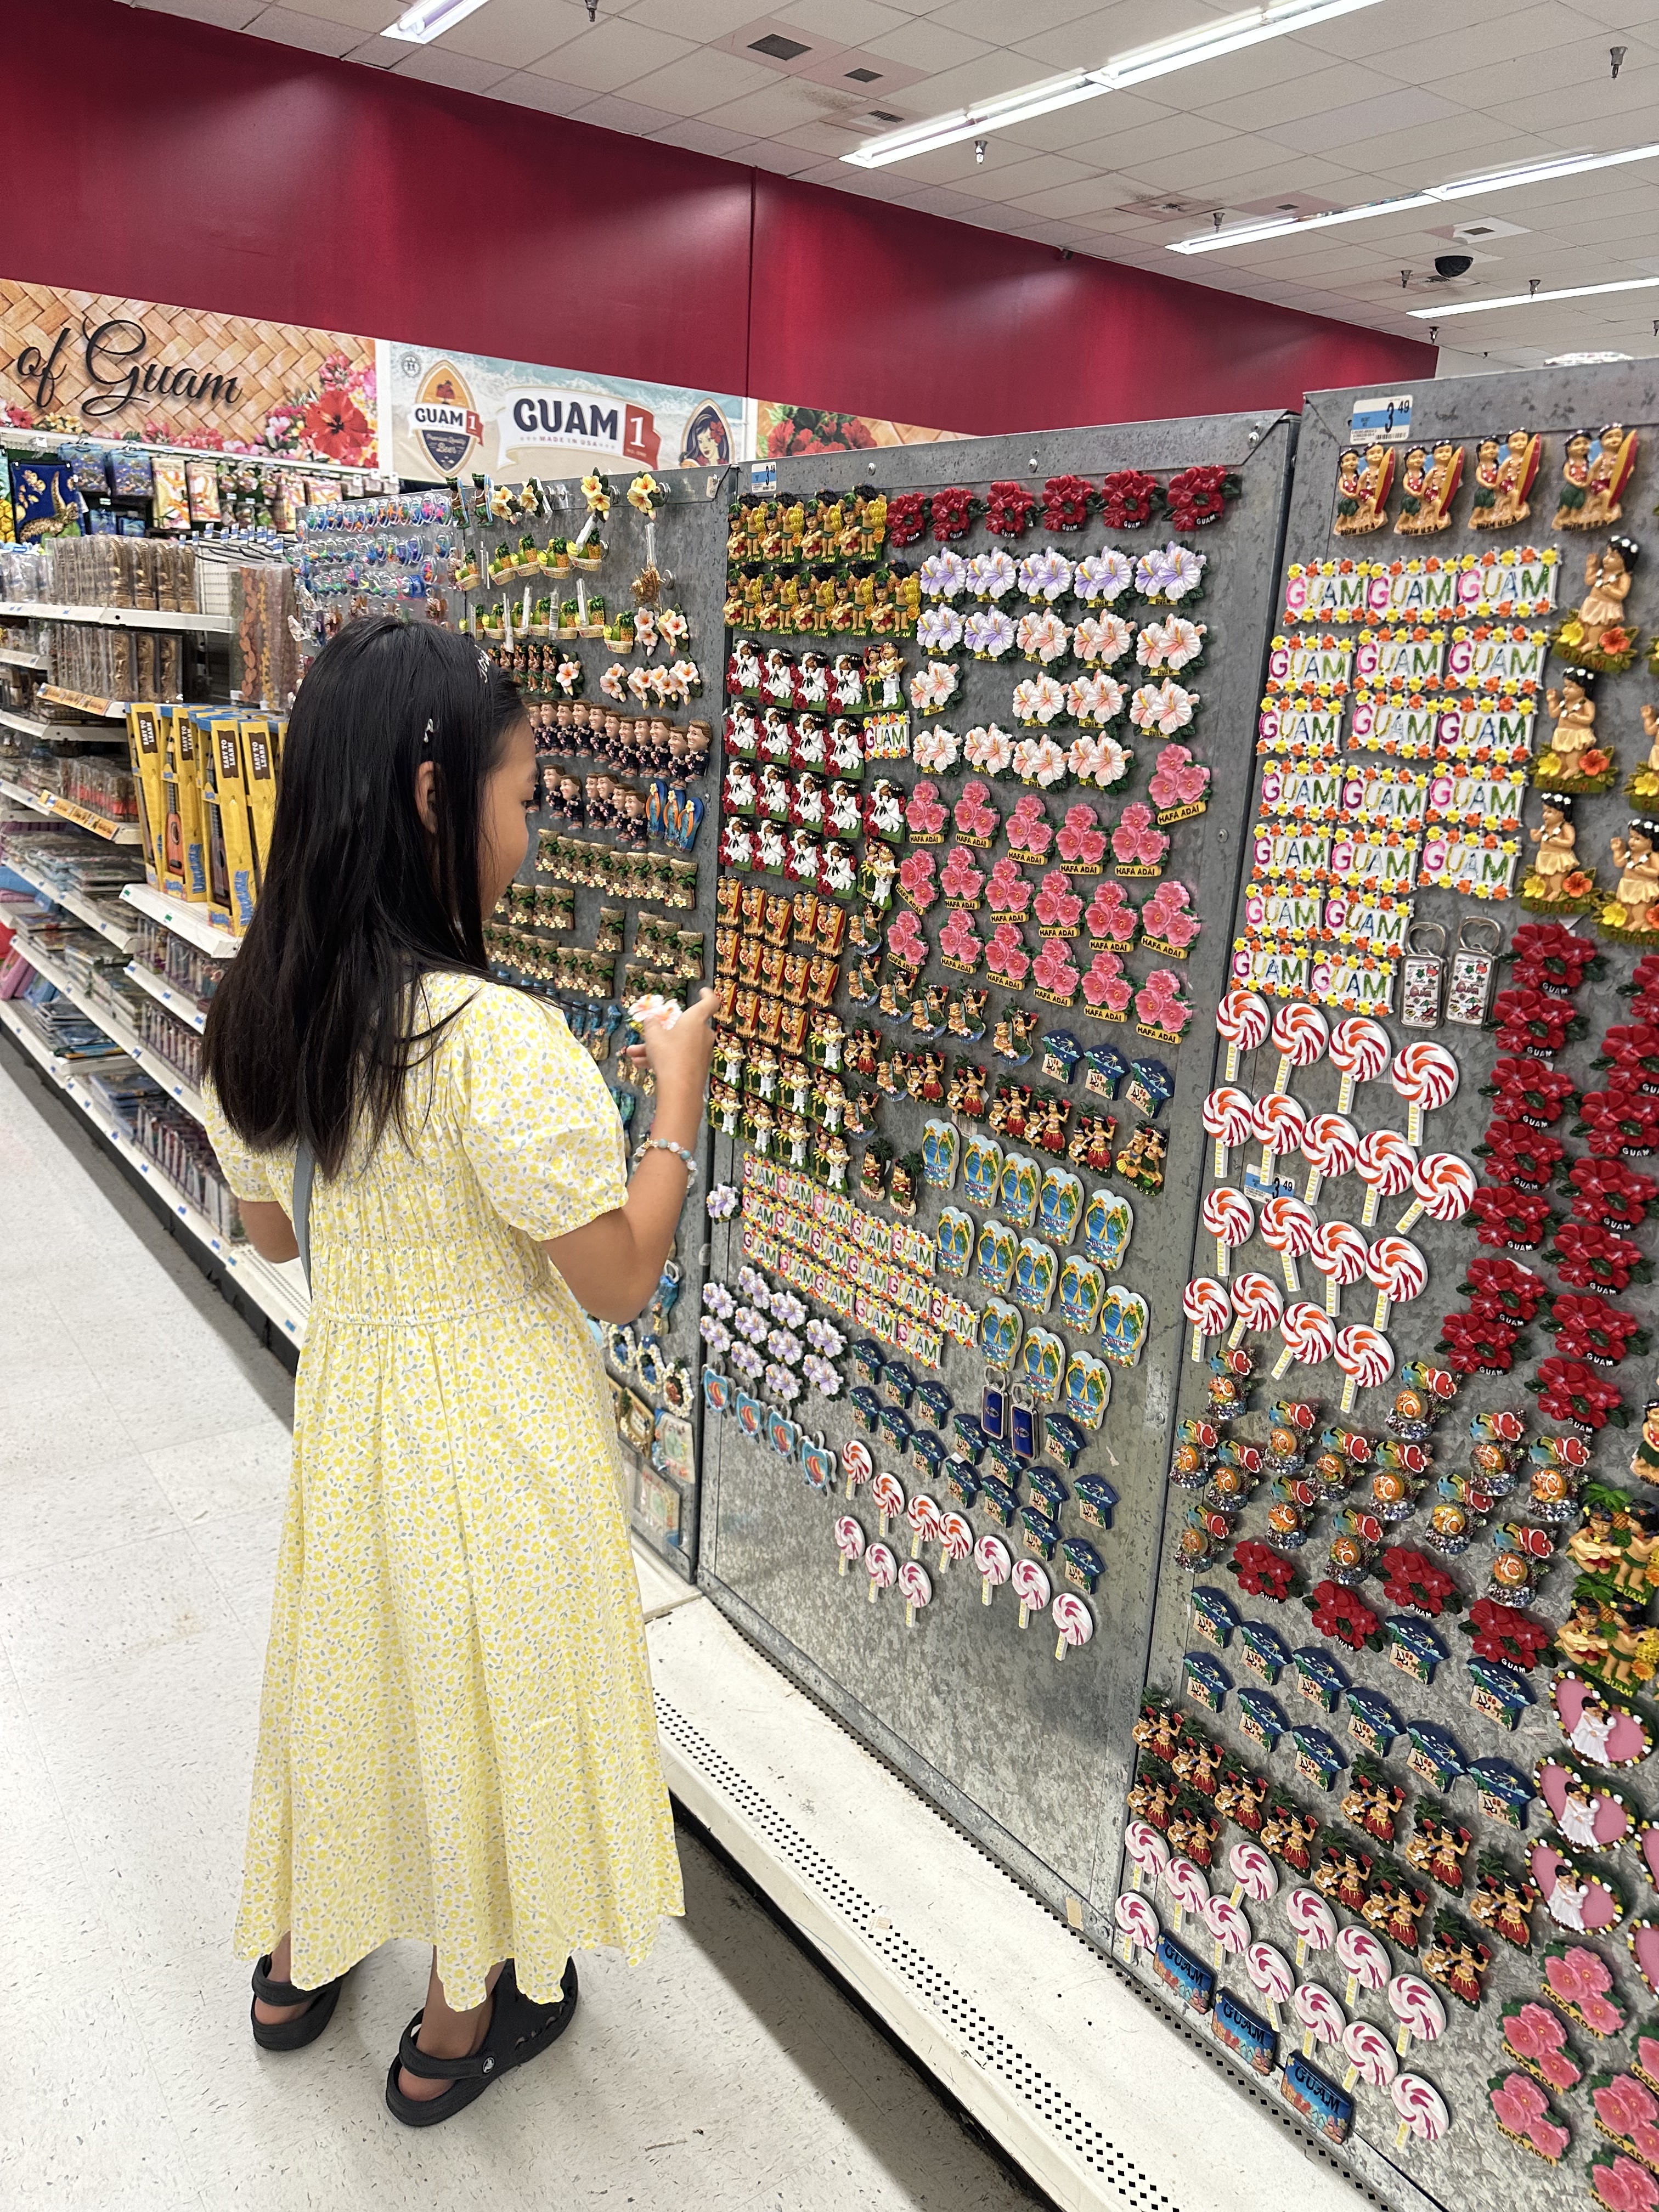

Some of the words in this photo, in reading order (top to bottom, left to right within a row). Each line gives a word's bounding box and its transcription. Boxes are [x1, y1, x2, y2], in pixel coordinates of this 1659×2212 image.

[17, 328, 71, 407] of
[82, 317, 242, 416] Guam
[415, 408, 463, 426] GUAM
[469, 416, 477, 430] 1
[514, 398, 618, 440] GUAM
[630, 417, 645, 448] 1
[1385, 402, 1394, 433] 3
[1398, 400, 1409, 413] 49
[765, 466, 769, 486] 3
[1197, 514, 1216, 524] GUAM
[1285, 577, 1364, 608] GUAM
[1368, 577, 1451, 609] GUAM
[1458, 565, 1549, 603] GUAM
[1269, 648, 1346, 679] GUAM
[1357, 643, 1439, 674] GUAM
[1448, 640, 1536, 674] GUAM
[140, 720, 146, 729] TO
[864, 724, 906, 748] GUAM
[1259, 712, 1334, 739] GUAM
[1352, 704, 1432, 742] GUAM
[1438, 712, 1526, 744] GUAM
[221, 740, 227, 749] TO
[252, 742, 258, 752] TO
[1262, 772, 1335, 804] GUAM
[1342, 778, 1422, 814] GUAM
[1429, 777, 1517, 813] GUAM
[1159, 812, 1178, 823] HAFA
[1181, 805, 1199, 816] ADAI
[956, 835, 972, 844] HAFA
[1254, 836, 1325, 865] GUAM
[1009, 852, 1025, 861] HAFA
[1026, 855, 1041, 864] ADAI
[1331, 842, 1410, 878] GUAM
[1423, 840, 1508, 884] GUAM
[896, 885, 908, 901] HAFA
[909, 900, 921, 913] ADAI
[1245, 896, 1316, 925] GUAM
[1531, 902, 1575, 913] GUAM
[1325, 899, 1402, 940] GUAM
[1142, 938, 1161, 949] HAFA
[1163, 946, 1181, 957] ADAI
[888, 955, 902, 966] HAFA
[902, 963, 915, 972] ADAI
[941, 958, 956, 968] HAFA
[1232, 951, 1302, 984] GUAM
[988, 974, 1003, 984] HAFA
[1311, 963, 1386, 999] GUAM
[1543, 982, 1568, 995] GUAM
[1035, 990, 1051, 1000] HAFA
[1052, 996, 1068, 1005] ADAI
[1085, 1008, 1104, 1017] HAFA
[1138, 1026, 1156, 1036] HAFA
[1158, 1032, 1176, 1042] ADAI
[1527, 1046, 1552, 1058] GUAM
[1522, 1115, 1548, 1128] GUAM
[1623, 1147, 1650, 1157] GUAM
[744, 1160, 777, 1184] GUAM
[1283, 1180, 1292, 1192] 49
[1514, 1177, 1538, 1190] GUAM
[777, 1175, 812, 1201] GUAM
[743, 1195, 773, 1223] GUAM
[814, 1195, 850, 1222] GUAM
[775, 1210, 810, 1239] GUAM
[851, 1218, 890, 1246] GUAM
[1604, 1217, 1630, 1231] GUAM
[744, 1232, 776, 1262] GUAM
[811, 1230, 848, 1262] GUAM
[892, 1232, 932, 1265] GUAM
[1508, 1241, 1533, 1251] GUAM
[780, 1254, 814, 1283] GUAM
[849, 1256, 886, 1288] GUAM
[815, 1275, 850, 1306] GUAM
[888, 1276, 928, 1307] GUAM
[1590, 1282, 1616, 1295] GUAM
[855, 1299, 894, 1333] GUAM
[932, 1299, 973, 1336] GUAM
[1499, 1313, 1524, 1327] GUAM
[897, 1323, 937, 1357] GUAM
[1480, 1366, 1503, 1376] GUAM
[1587, 1352, 1613, 1366] GUAM
[1568, 1418, 1593, 1433] GUAM
[1260, 1592, 1279, 1604] GUAM
[1616, 1587, 1647, 1605] GUAM
[1410, 1604, 1432, 1618] GUAM
[1501, 1657, 1526, 1673] GUAM
[1603, 1678, 1633, 1697] GUAM
[1165, 1944, 1203, 1987] GUAM
[1223, 2002, 1264, 2044] GUAM
[1543, 1987, 1571, 2015] HAFA
[1572, 2014, 1600, 2039] ADAI
[1504, 2047, 1530, 2073] HAFA
[1532, 2071, 1559, 2092] ADAI
[1295, 2066, 1340, 2112] GUAM
[1498, 2125, 1524, 2148] HAFA
[1527, 2145, 1554, 2165] ADAI
[1595, 2123, 1625, 2148] HAFA
[1628, 2147, 1658, 2170] ADAI
